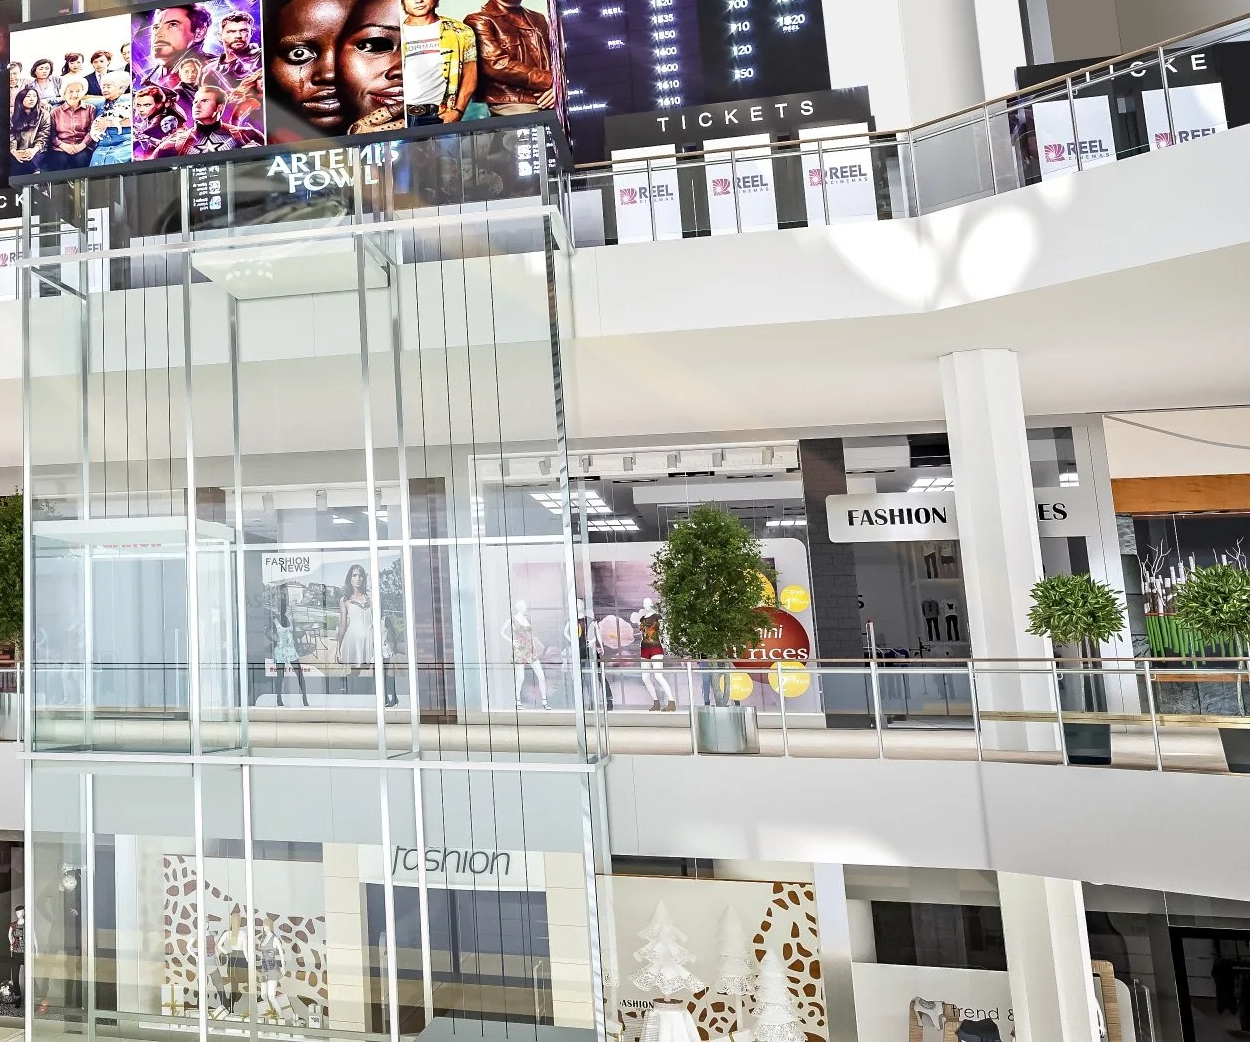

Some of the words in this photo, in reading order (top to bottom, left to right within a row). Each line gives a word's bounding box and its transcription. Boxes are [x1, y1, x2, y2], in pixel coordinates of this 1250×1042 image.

[657, 100, 814, 132] TICKETS
[1066, 139, 1109, 156] REEL
[288, 165, 379, 194] FOWL
[829, 164, 868, 180] REEL
[831, 177, 868, 185] CINEMAS
[638, 184, 673, 199] REEL
[847, 506, 947, 526] FASHION
[265, 557, 310, 566] FASHION
[280, 564, 310, 573] NEWS
[620, 999, 654, 1009] ASHION
[951, 1004, 999, 1020] trend
